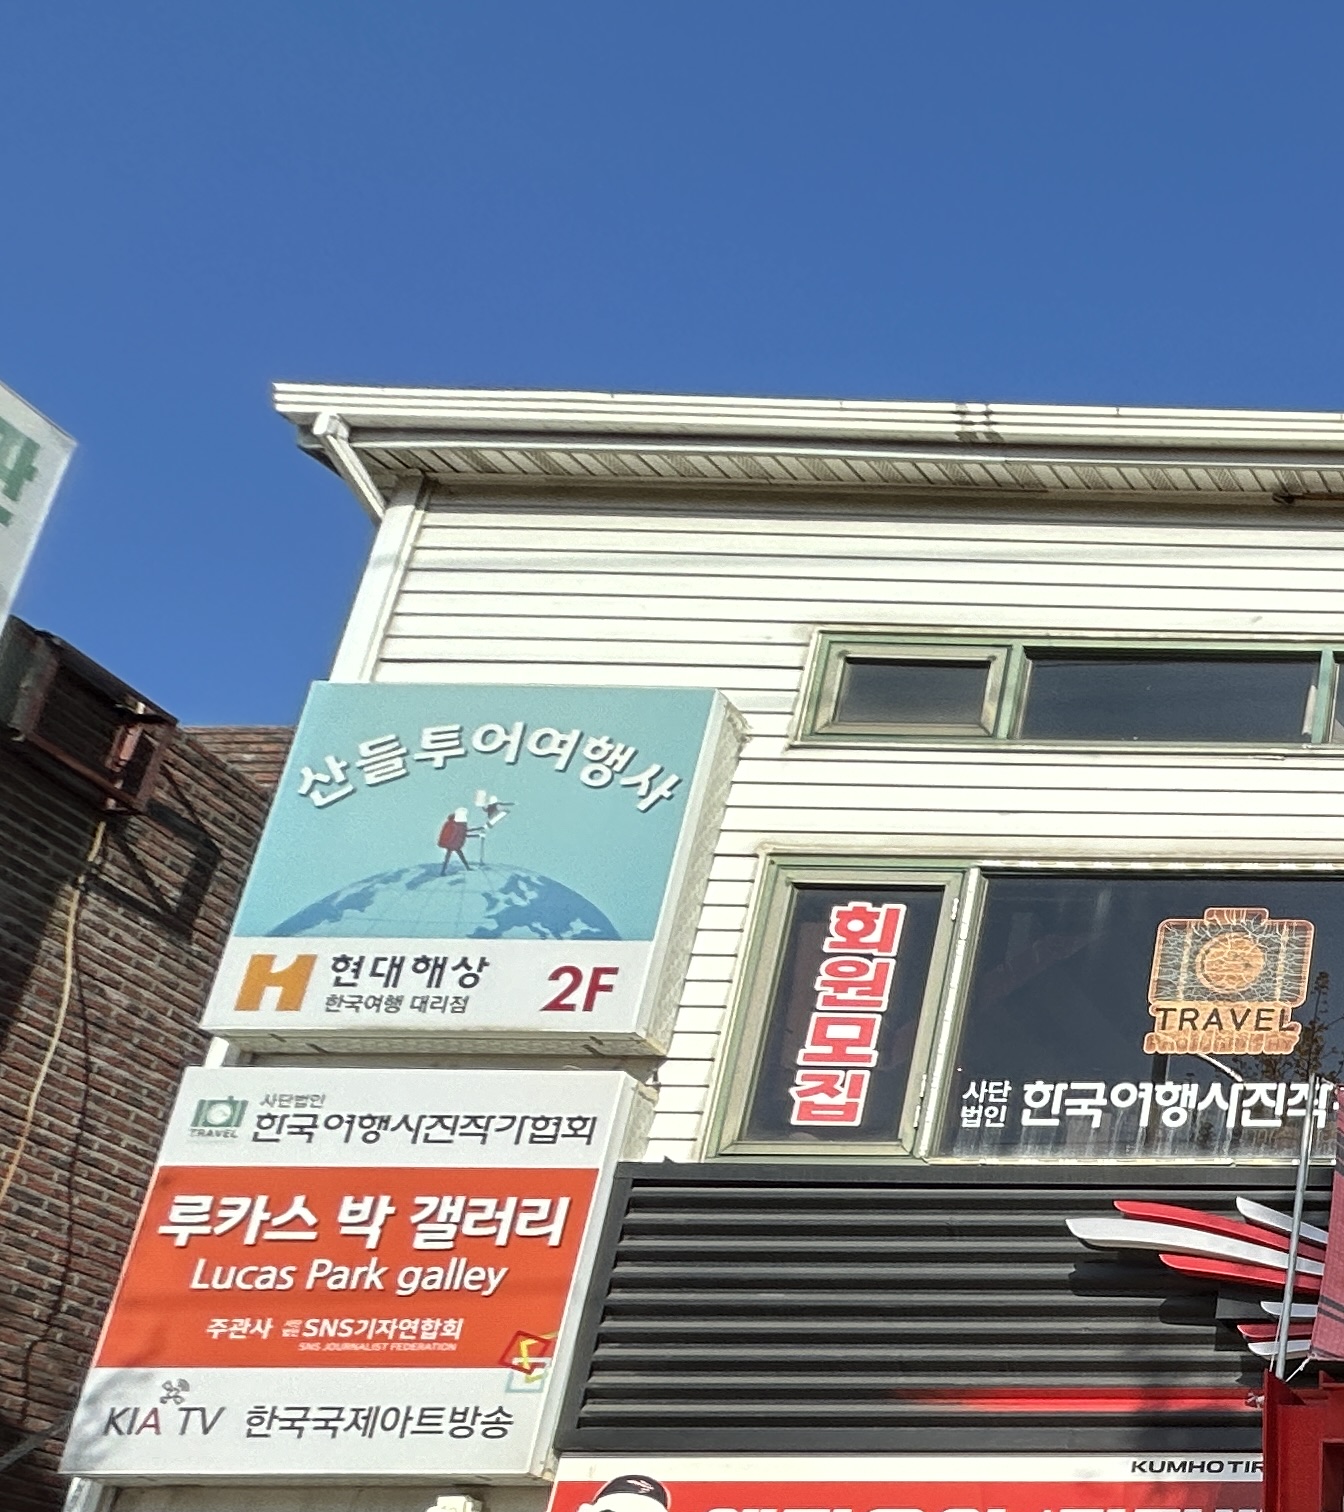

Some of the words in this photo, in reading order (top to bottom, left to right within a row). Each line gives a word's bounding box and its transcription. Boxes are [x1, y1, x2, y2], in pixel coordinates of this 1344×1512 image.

[299, 720, 685, 813] 산들투어여행사
[331, 953, 490, 990] 현대해상
[540, 965, 620, 1012] 2F
[324, 994, 403, 1014] 한국여행
[410, 994, 470, 1015] 대리점
[790, 901, 906, 1126] 회원모집
[1156, 1007, 1296, 1032] TRAVEL
[962, 1079, 1011, 1103] 사단
[251, 1113, 598, 1145] 한국여행사진작가협회
[961, 1104, 1006, 1129] 법인
[158, 1194, 318, 1247] 루카스
[337, 1194, 396, 1250] 박
[408, 1194, 571, 1250] 갤러리
[190, 1258, 294, 1291] Lucas
[305, 1258, 389, 1290] Park
[394, 1257, 508, 1296] galley
[206, 1318, 273, 1340] 주관사
[302, 1318, 465, 1341] SNS기자연합회
[102, 1406, 162, 1436] KIA
[177, 1406, 226, 1436] TV
[245, 1404, 514, 1440] 한국국제아트방송
[1131, 1460, 1225, 1473] KUMHO
